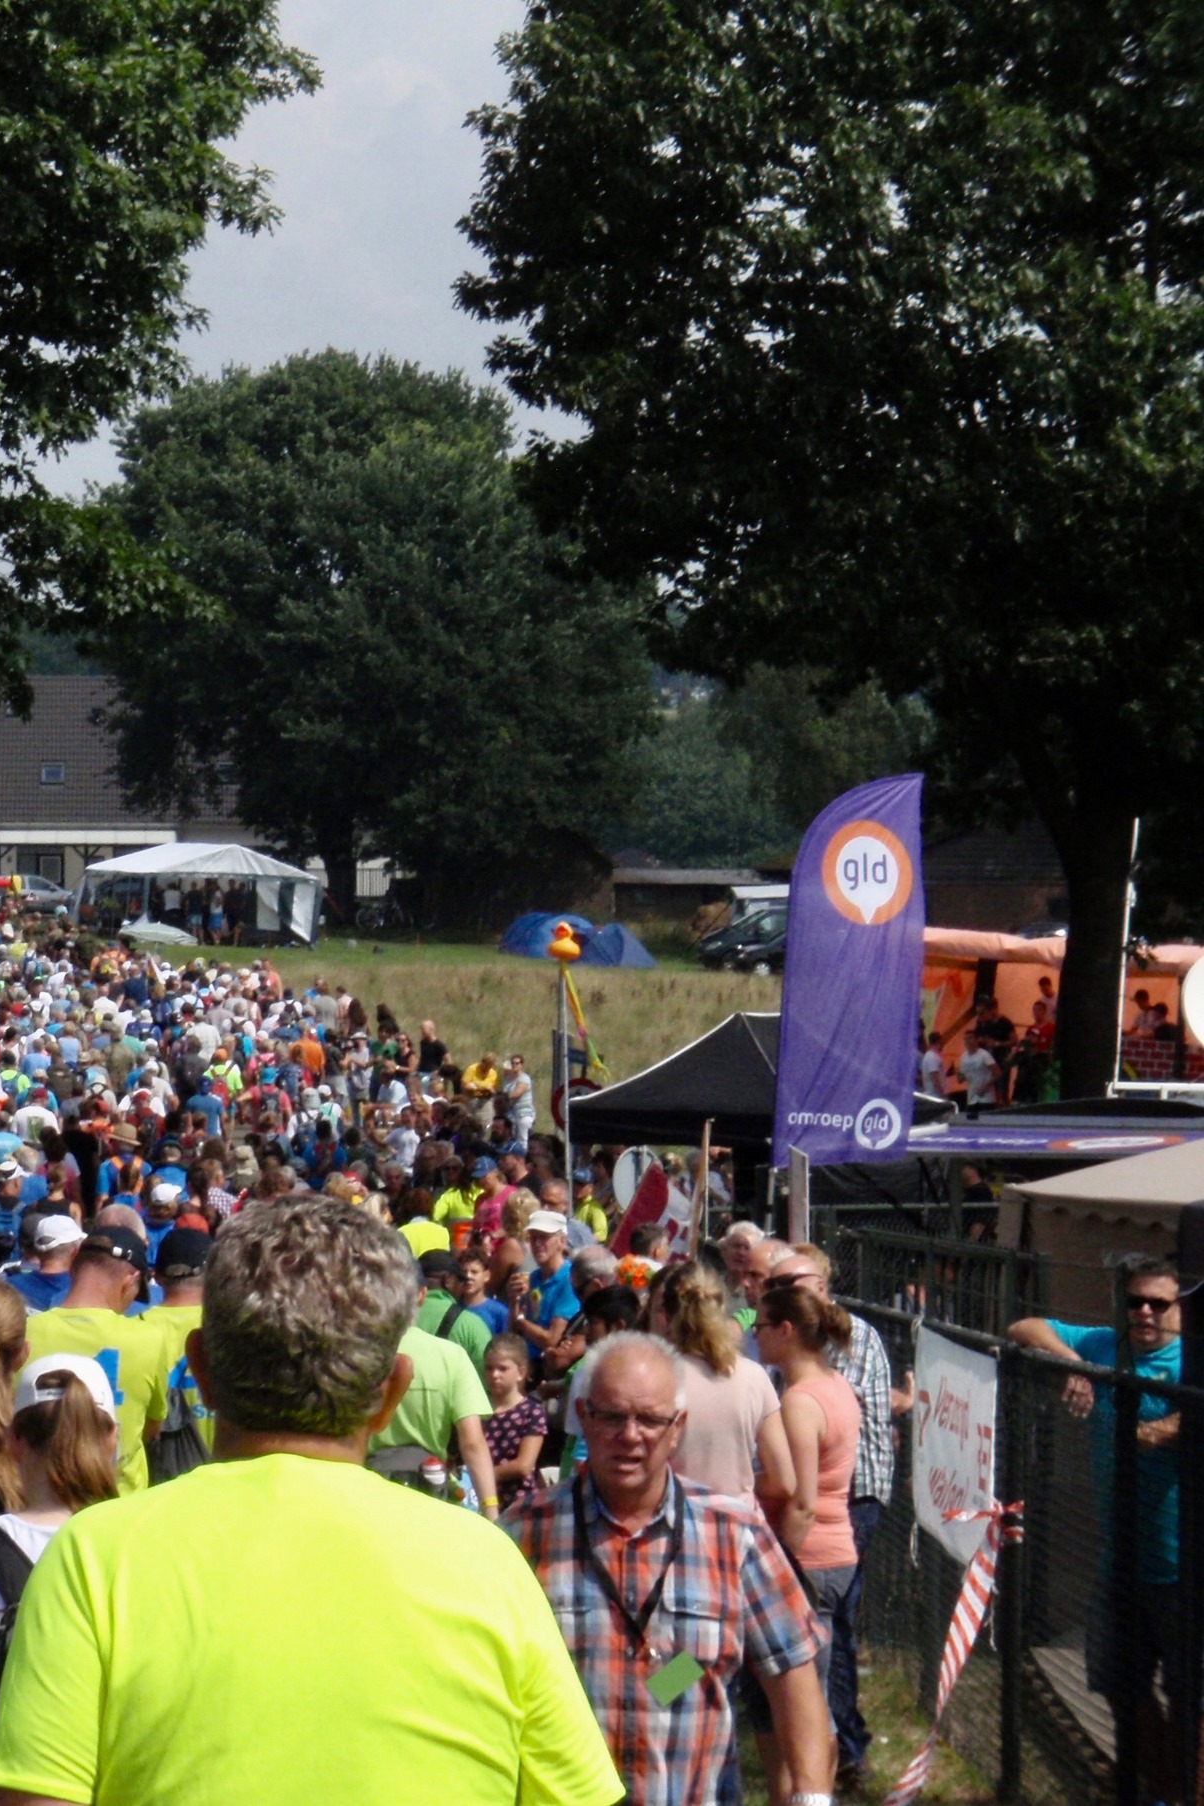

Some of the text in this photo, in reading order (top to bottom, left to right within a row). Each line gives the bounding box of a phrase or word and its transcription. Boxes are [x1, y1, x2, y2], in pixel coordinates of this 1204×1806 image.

[843, 851, 888, 891] gld
[787, 1112, 889, 1133] omroep gld
